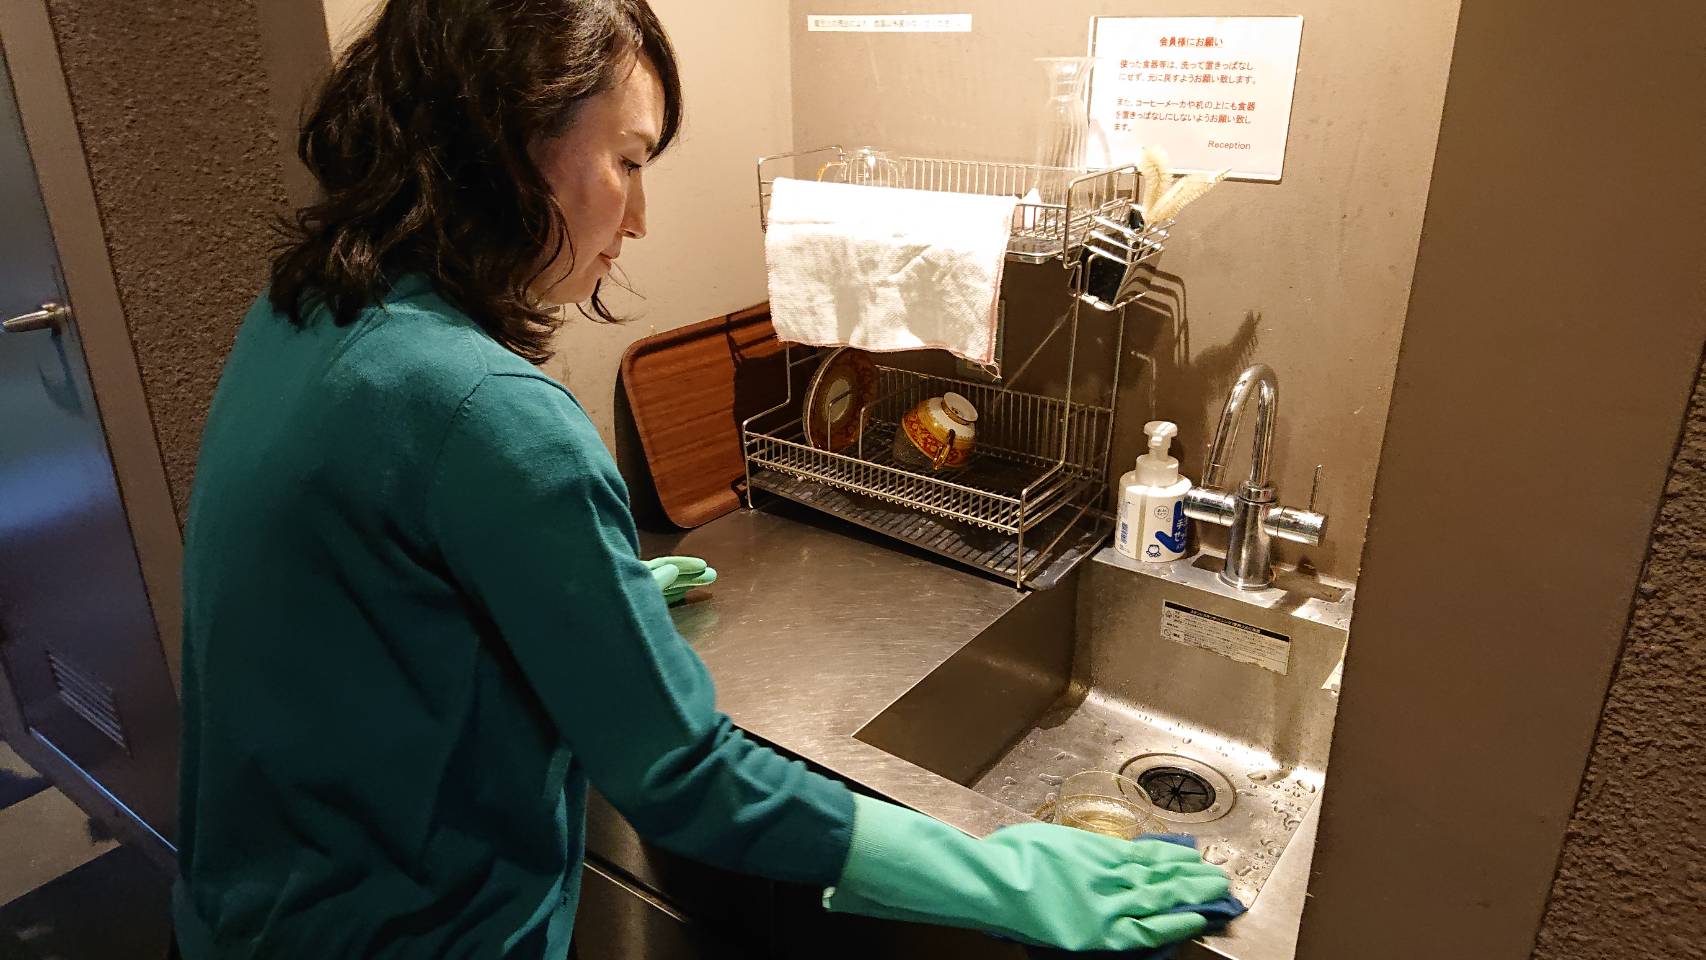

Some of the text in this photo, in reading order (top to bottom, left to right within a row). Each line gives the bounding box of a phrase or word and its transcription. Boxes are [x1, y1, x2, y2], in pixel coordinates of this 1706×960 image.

[1159, 36, 1224, 48] 会員様にお願い
[1114, 123, 1133, 132] ます。
[1207, 140, 1251, 150] Reception
